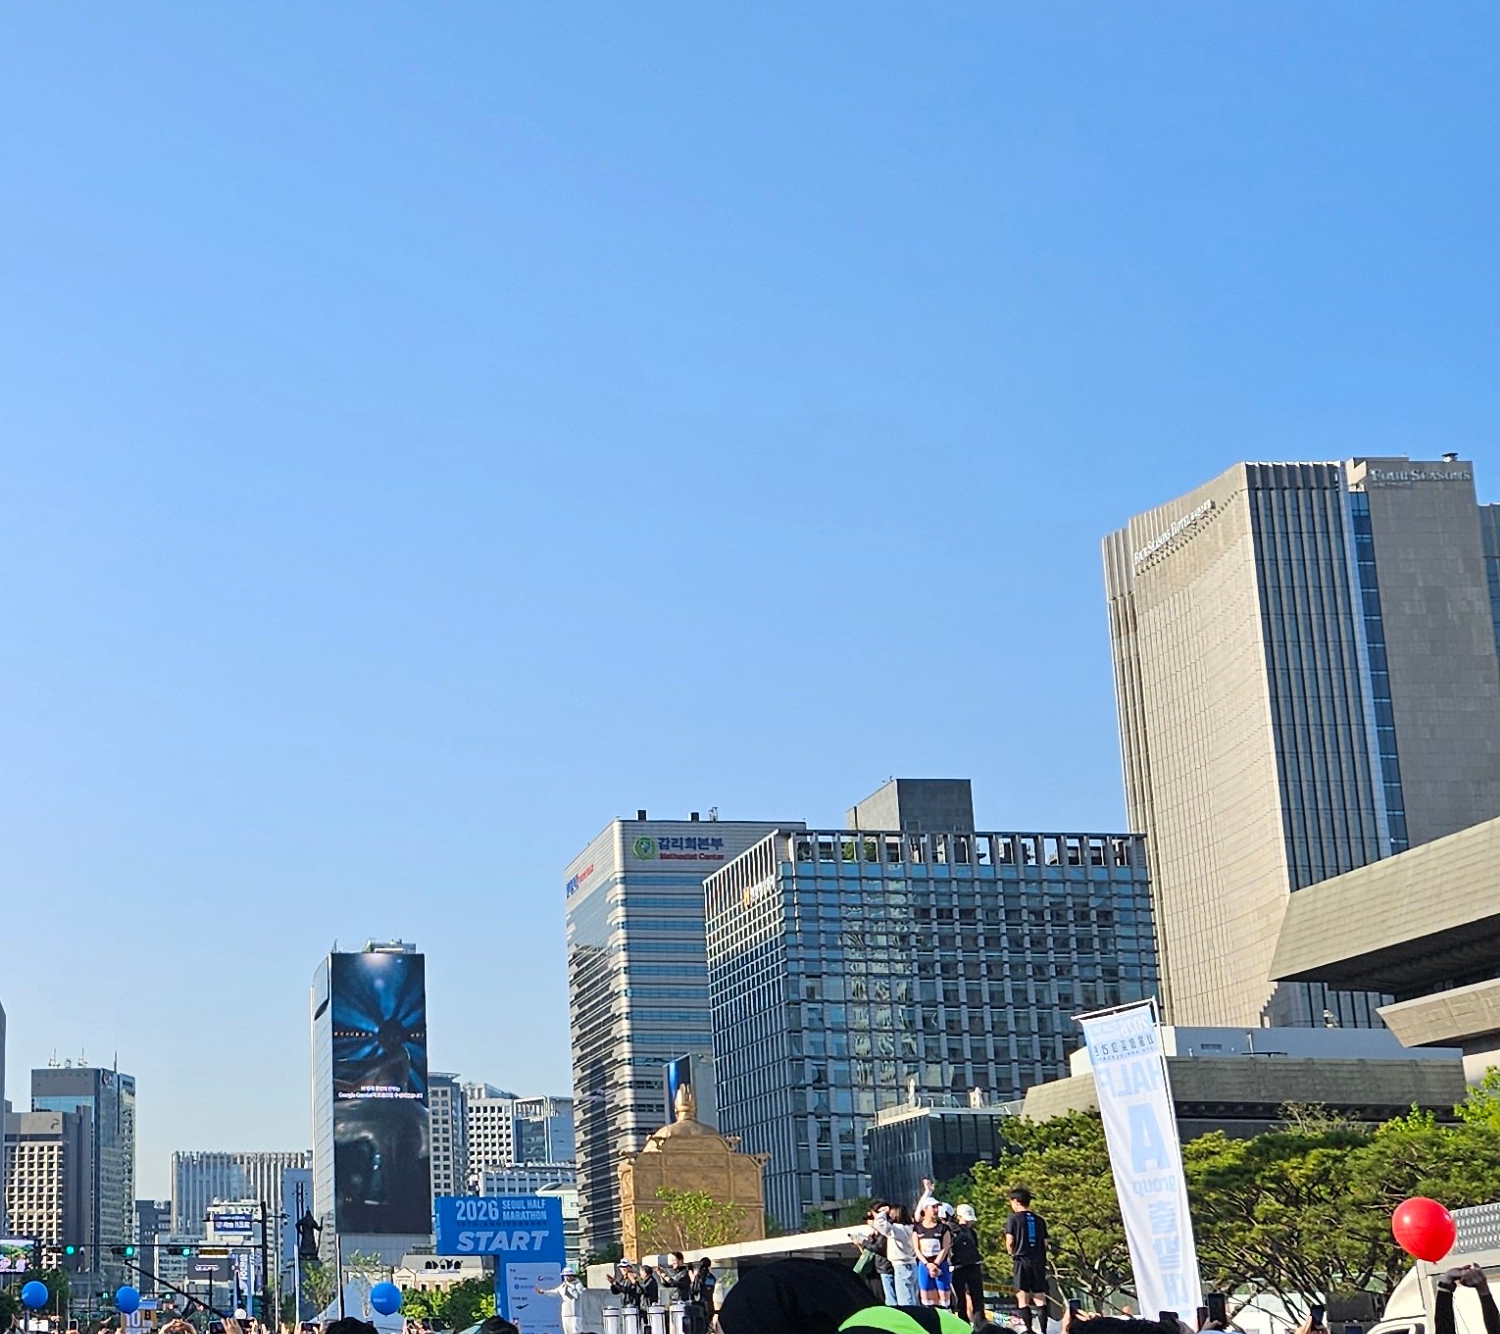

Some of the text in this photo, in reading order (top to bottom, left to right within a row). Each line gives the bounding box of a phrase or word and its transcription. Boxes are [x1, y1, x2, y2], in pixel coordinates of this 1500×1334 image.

[658, 837, 724, 850] 감리회본부
[455, 1199, 545, 1222] 2026 SEOUL HALF
[503, 1211, 547, 1221] MARATHON
[457, 1231, 549, 1251] START
